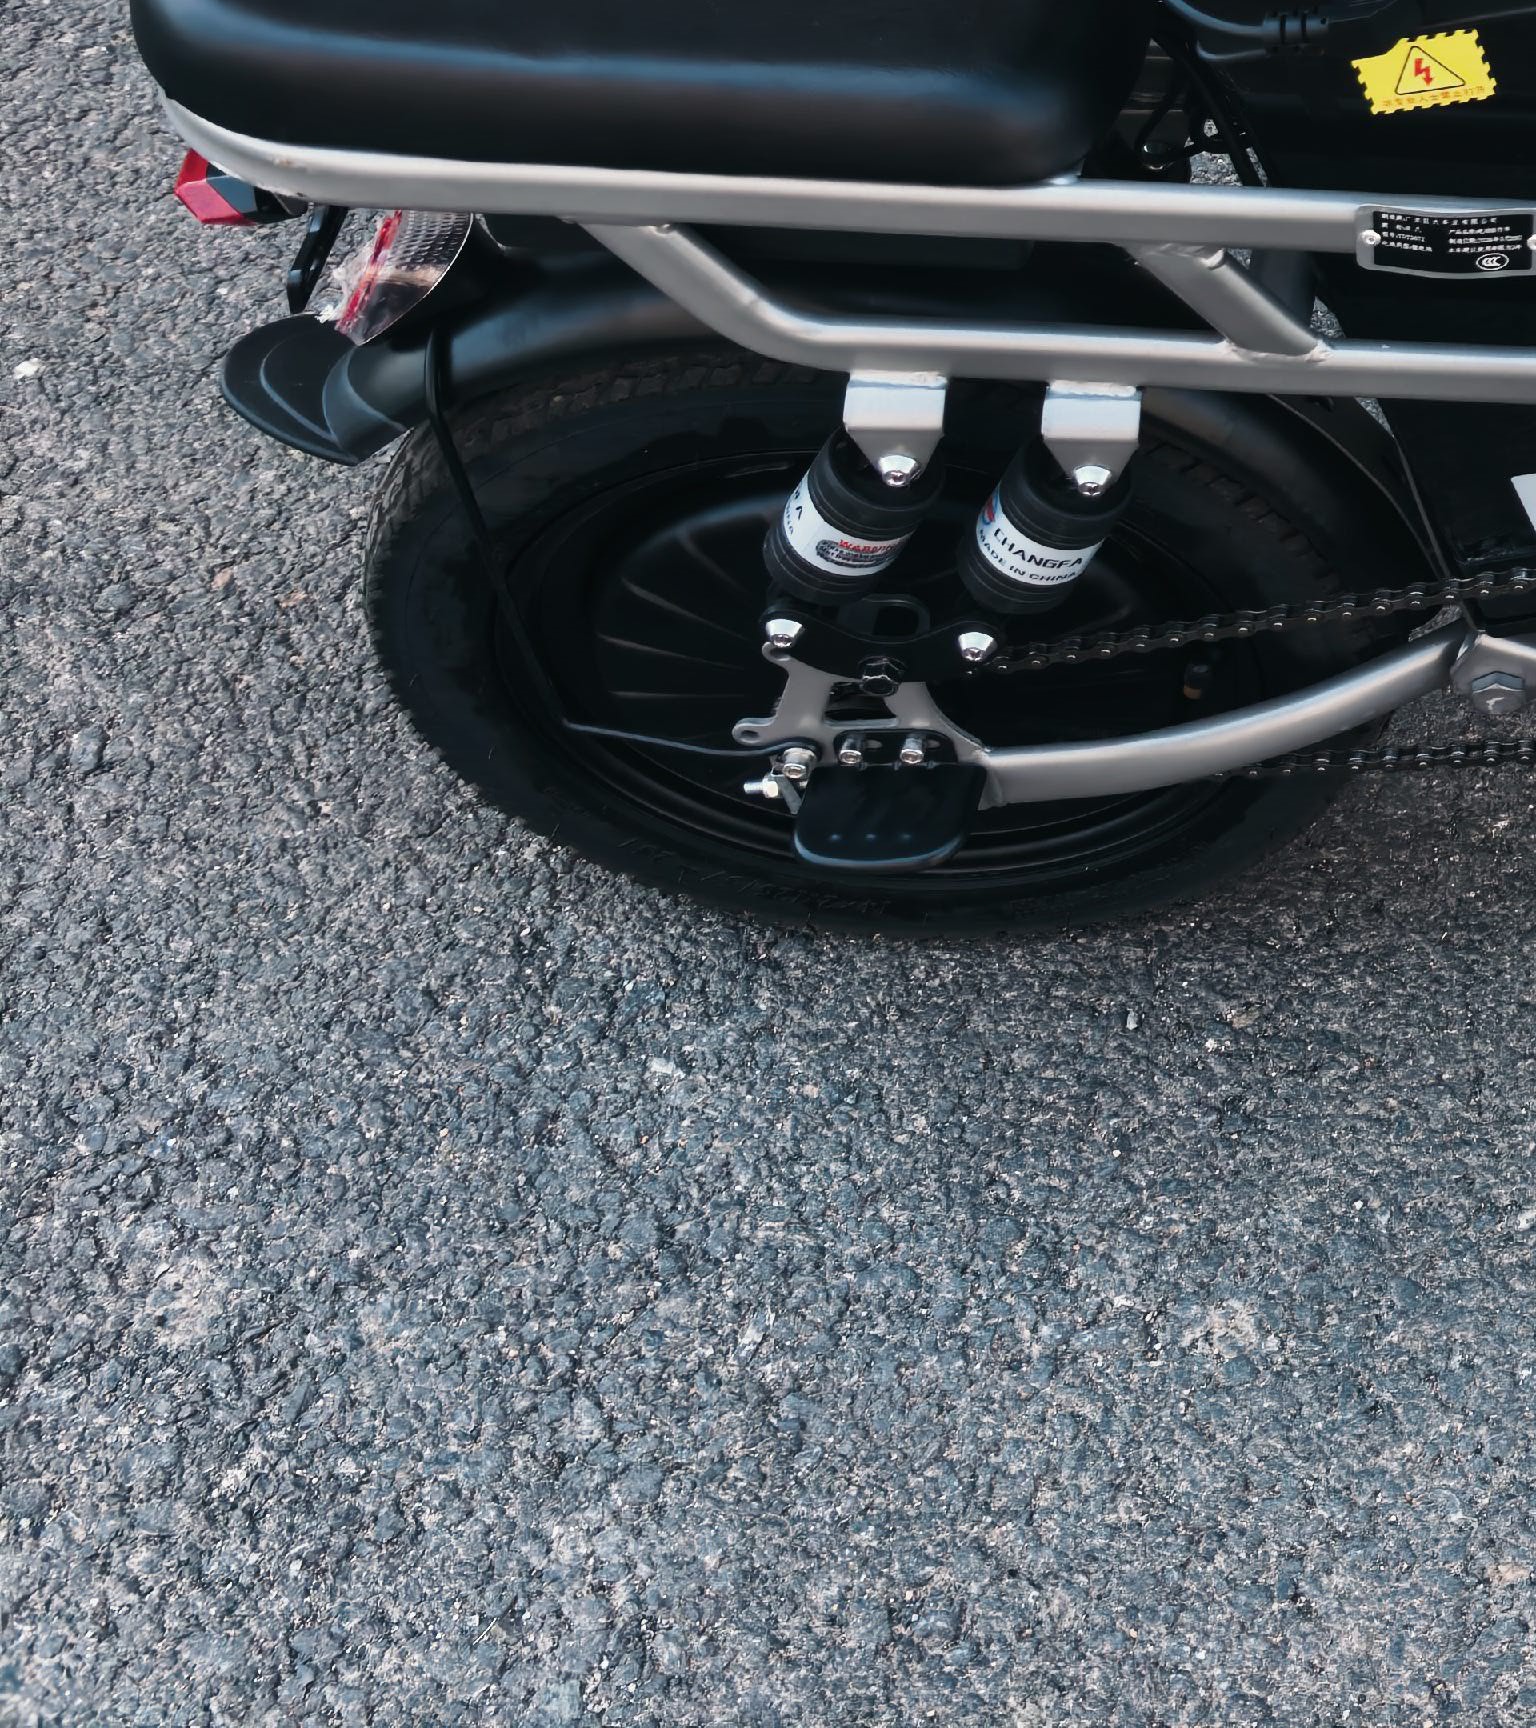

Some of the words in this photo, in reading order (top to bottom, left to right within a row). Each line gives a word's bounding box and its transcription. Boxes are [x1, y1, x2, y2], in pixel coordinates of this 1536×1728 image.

[979, 529, 1007, 566] MADE
[1009, 565, 1026, 576] IN
[1028, 571, 1077, 582] CHINA
[993, 527, 1083, 570] CHANGFA
